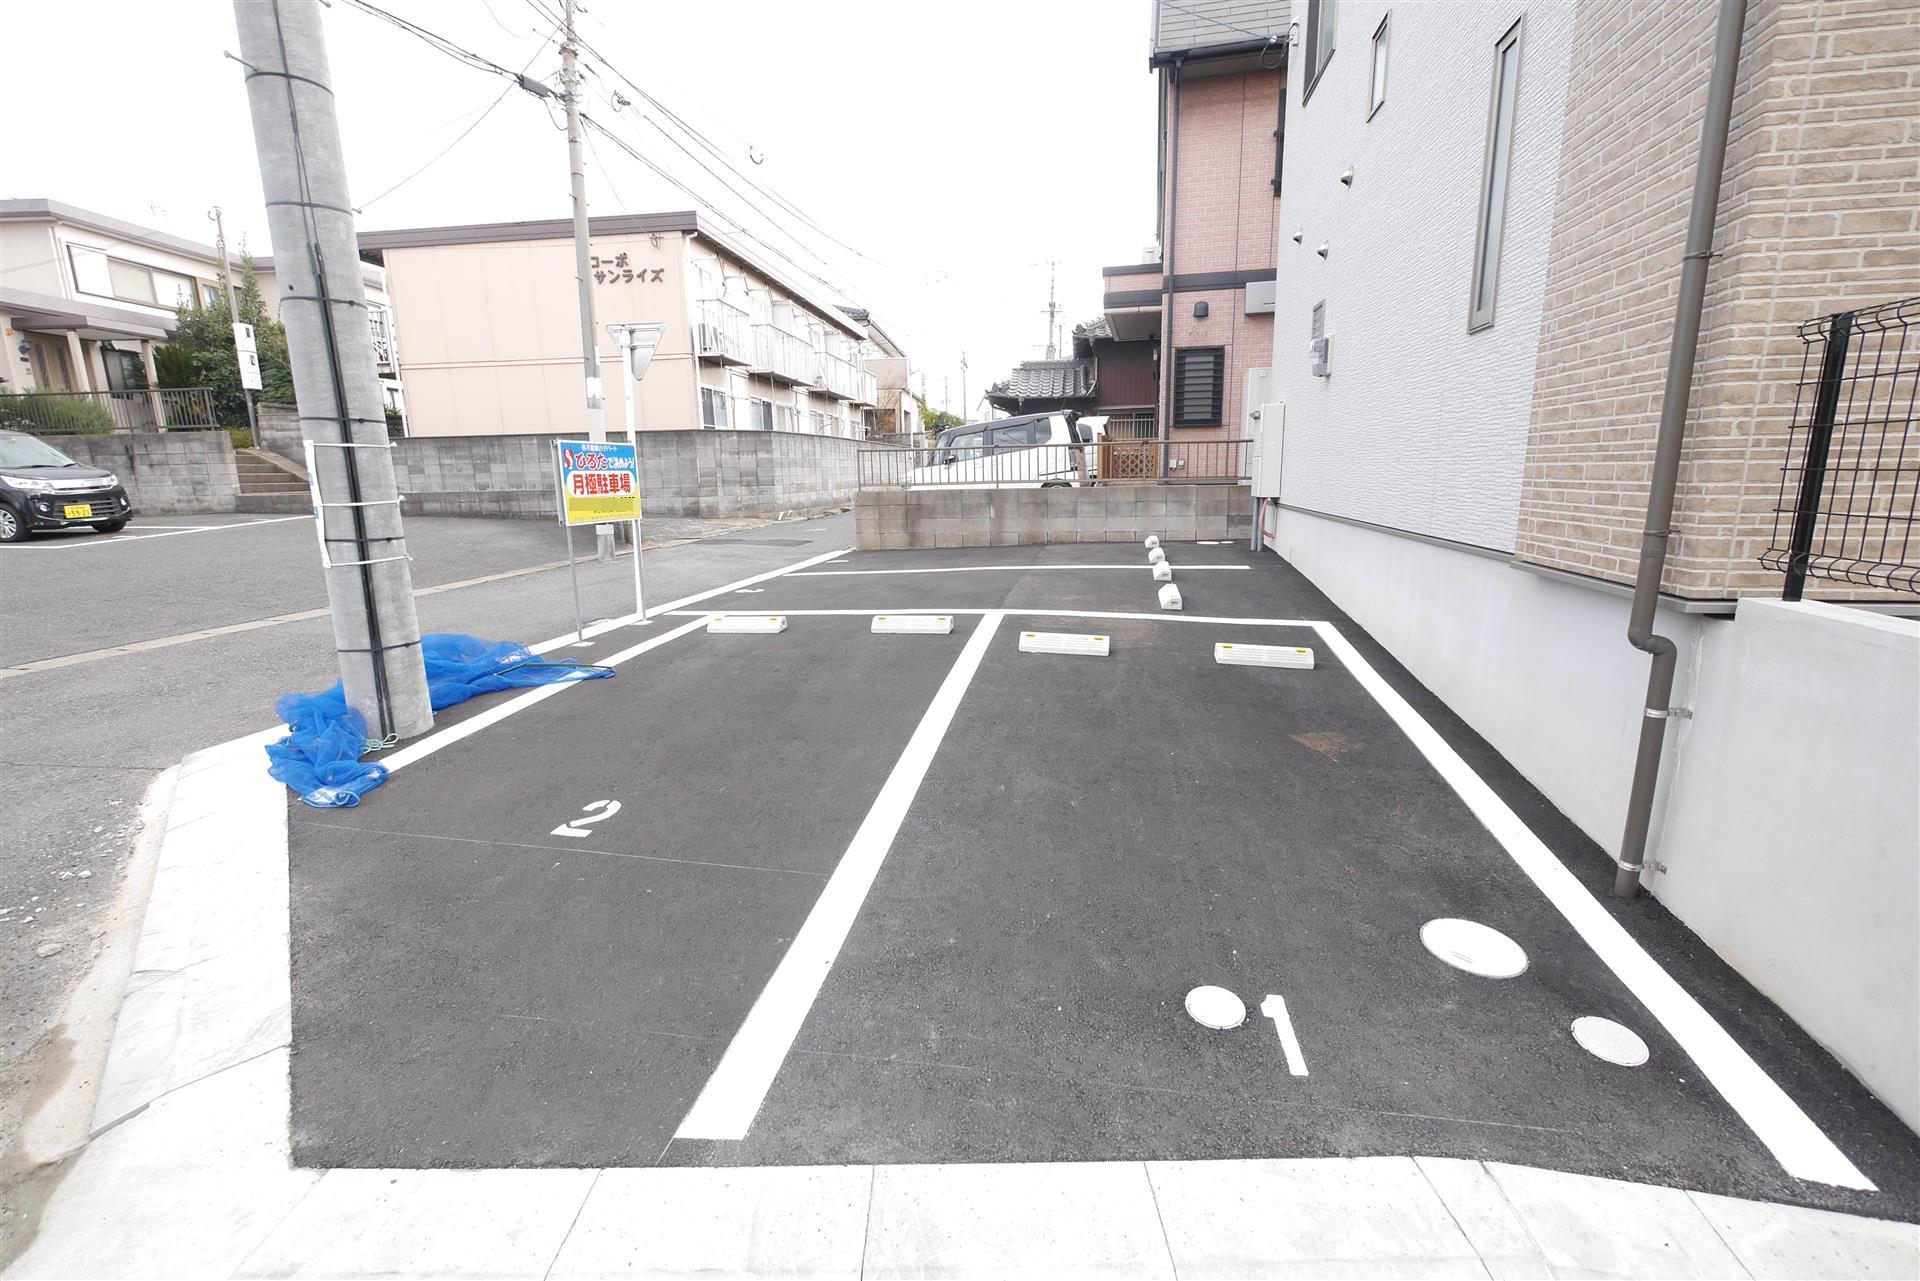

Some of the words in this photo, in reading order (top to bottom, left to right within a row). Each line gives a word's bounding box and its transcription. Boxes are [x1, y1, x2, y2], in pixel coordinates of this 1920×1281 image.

[591, 252, 629, 268] コーポ
[594, 268, 664, 284] サンライズ
[572, 473, 631, 495] 月極駐車場
[550, 800, 622, 838] 2
[1260, 994, 1309, 1076] 1
